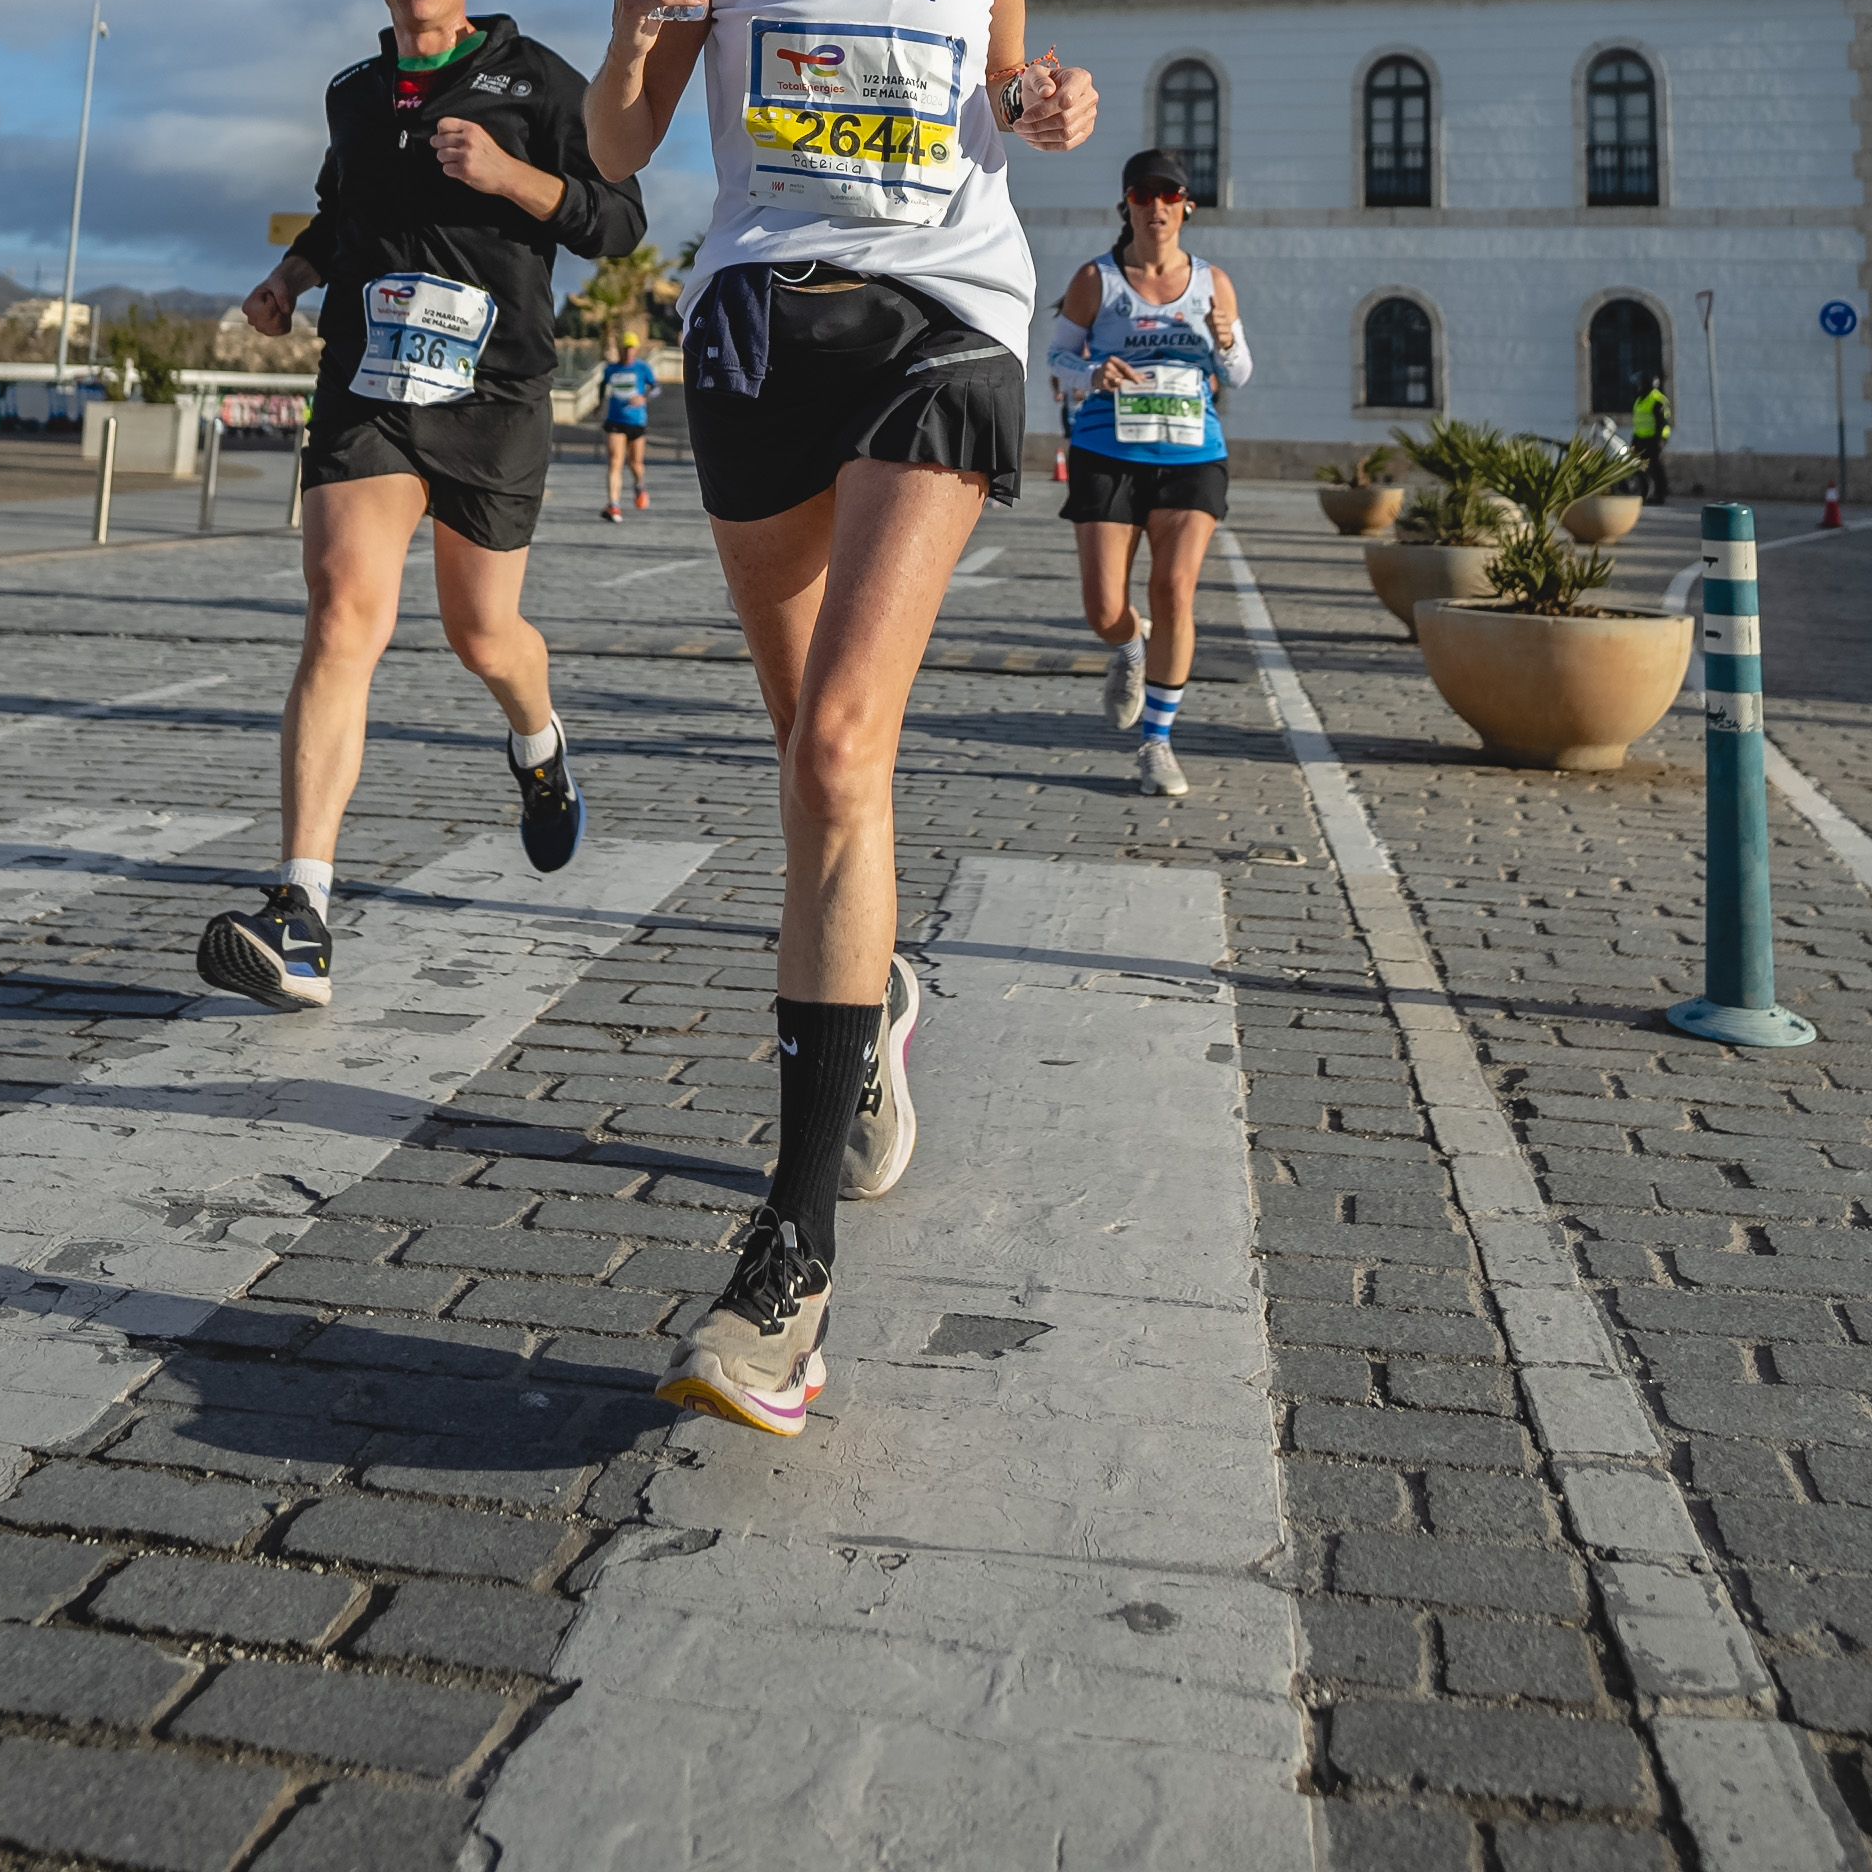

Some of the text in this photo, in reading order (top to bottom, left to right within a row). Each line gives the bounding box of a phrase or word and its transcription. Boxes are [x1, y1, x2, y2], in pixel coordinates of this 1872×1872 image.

[863, 74, 880, 84] 1/2
[777, 81, 846, 95] TotalEnergies
[862, 88, 877, 98] DE
[792, 110, 926, 166] 2644
[424, 307, 435, 317] 1/2
[421, 316, 432, 325] DE
[389, 329, 447, 369] 136
